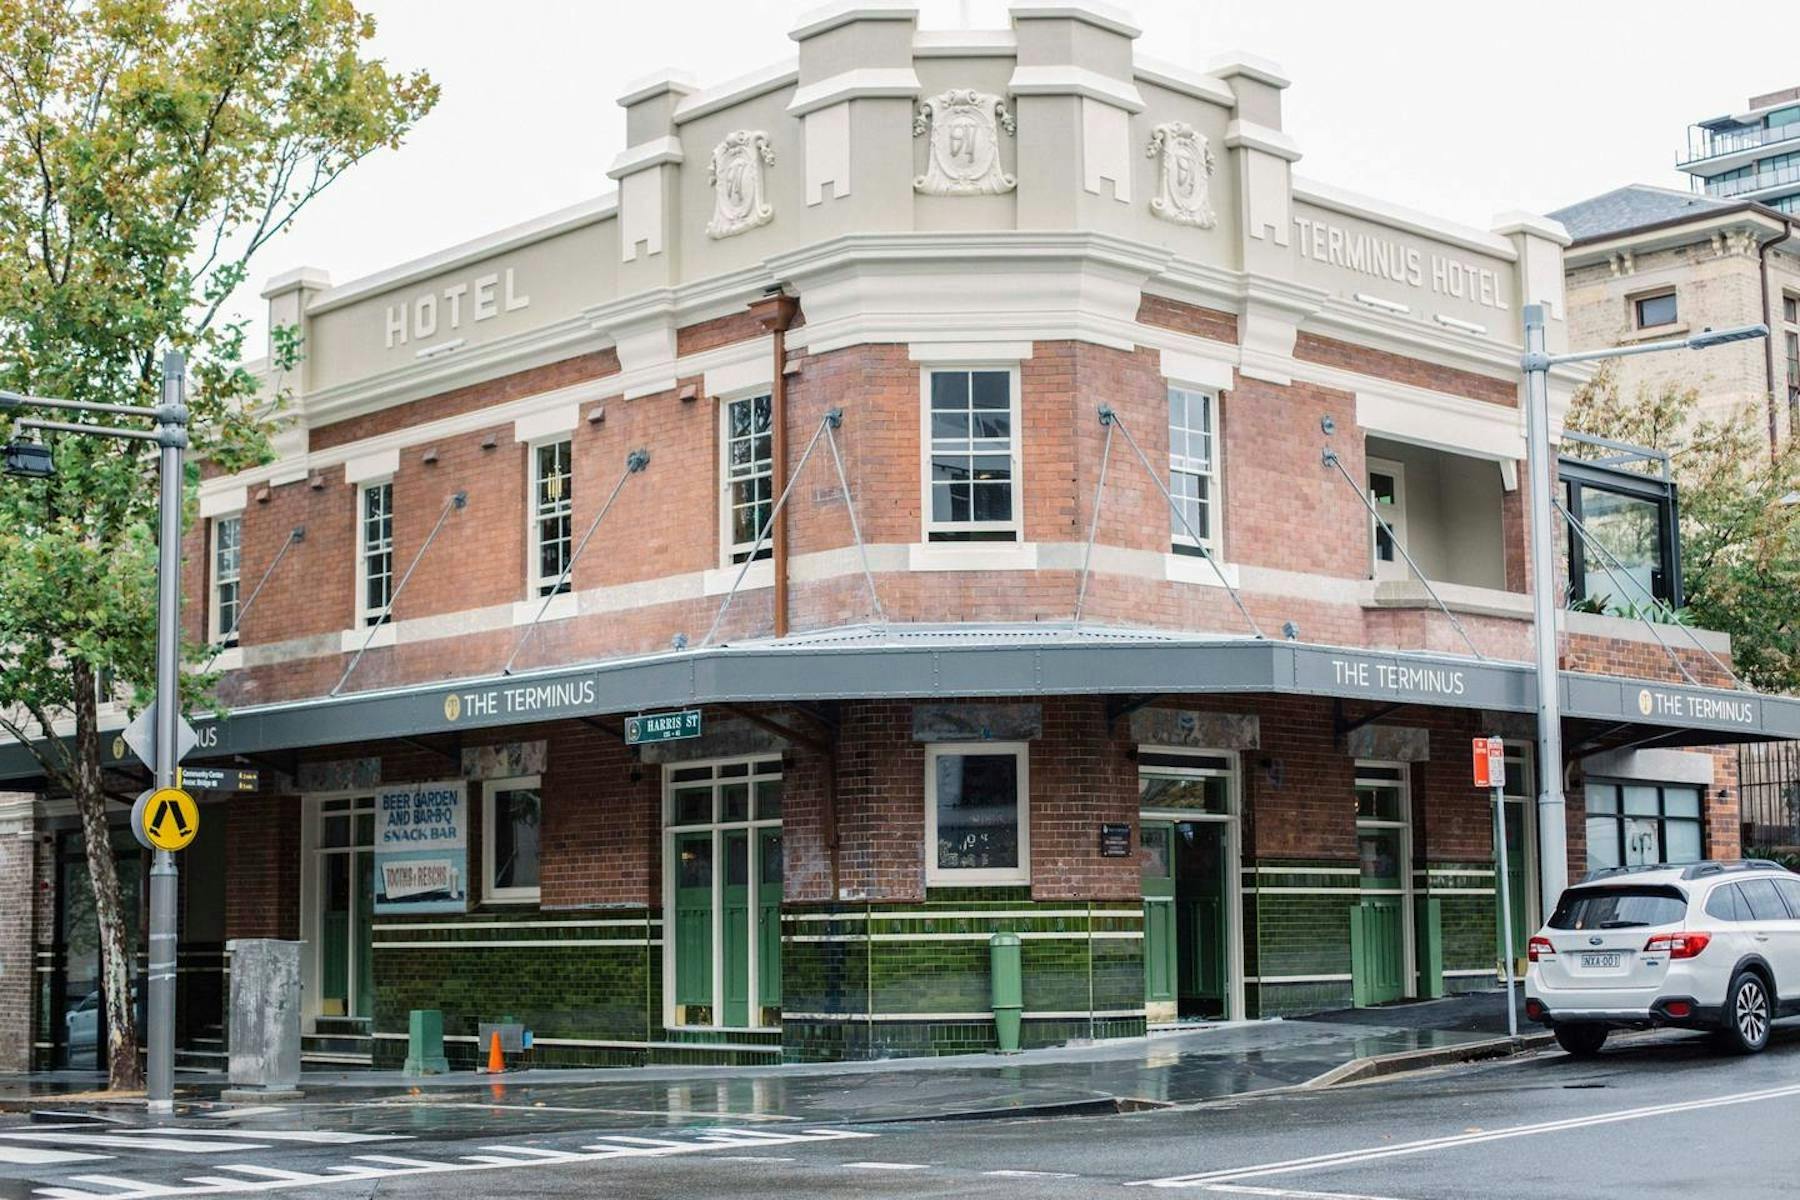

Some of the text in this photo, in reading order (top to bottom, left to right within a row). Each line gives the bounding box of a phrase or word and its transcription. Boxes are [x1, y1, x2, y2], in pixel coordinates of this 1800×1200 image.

[1293, 217, 1509, 311] TERMINUS HOTEL
[386, 268, 530, 349] HOTEL
[1332, 660, 1464, 695] THE TERMINUS
[464, 680, 595, 717] THE TERMINUS
[1655, 693, 1753, 723] THE TERMINUS
[647, 714, 698, 732] HARRIS ST
[383, 790, 458, 810] BEER GARDEN
[387, 810, 411, 827] AND
[383, 826, 457, 842] SNACK BAR
